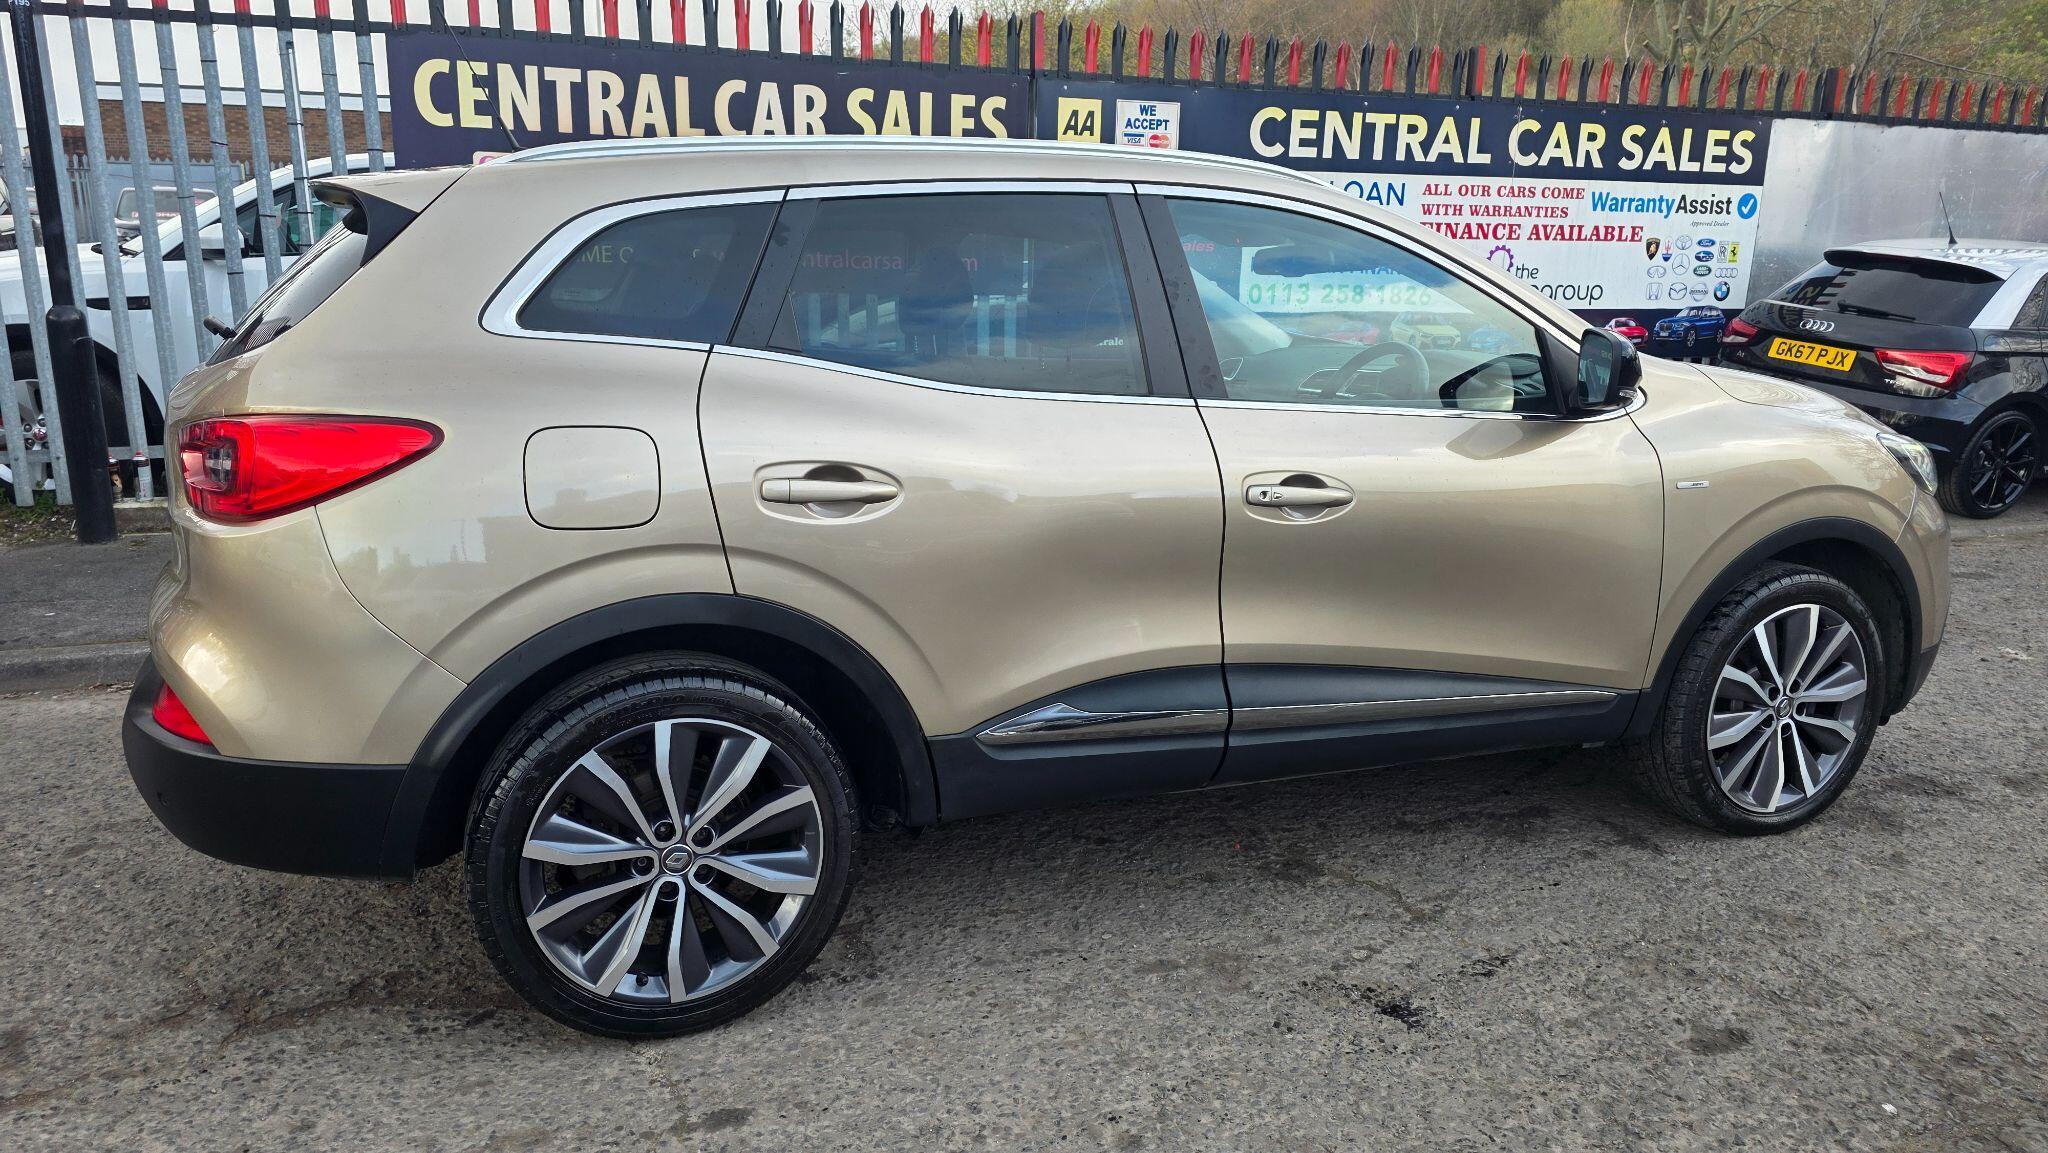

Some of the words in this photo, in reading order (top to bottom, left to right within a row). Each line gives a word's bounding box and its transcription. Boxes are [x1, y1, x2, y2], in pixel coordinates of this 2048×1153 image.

[413, 58, 706, 138] CENTRAL
[714, 79, 827, 136] CAR
[846, 87, 1008, 138] SALES
[1140, 104, 1156, 117] WE
[1062, 109, 1095, 136] AA
[1125, 117, 1169, 131] ACCEPT
[1249, 106, 1492, 164] CENTRAL
[1508, 119, 1606, 168] CAR
[1617, 124, 1756, 174] SALES
[1332, 180, 1406, 206] OAN
[1422, 183, 1452, 196] ALL
[1458, 184, 1491, 197] OUR
[1496, 185, 1537, 199] CARS
[1541, 186, 1585, 200] COME
[1421, 203, 1464, 216] WITH
[1469, 205, 1569, 218] WARRANTIES
[1527, 224, 1644, 243] AVAILABLE
[1182, 240, 1215, 252] ales
[1515, 264, 1539, 279] the
[1249, 283, 1310, 305] 0113
[1321, 284, 1364, 304] 258
[1530, 284, 1604, 306] group
[1776, 341, 1816, 360] GK67
[1816, 348, 1850, 368] PJX
